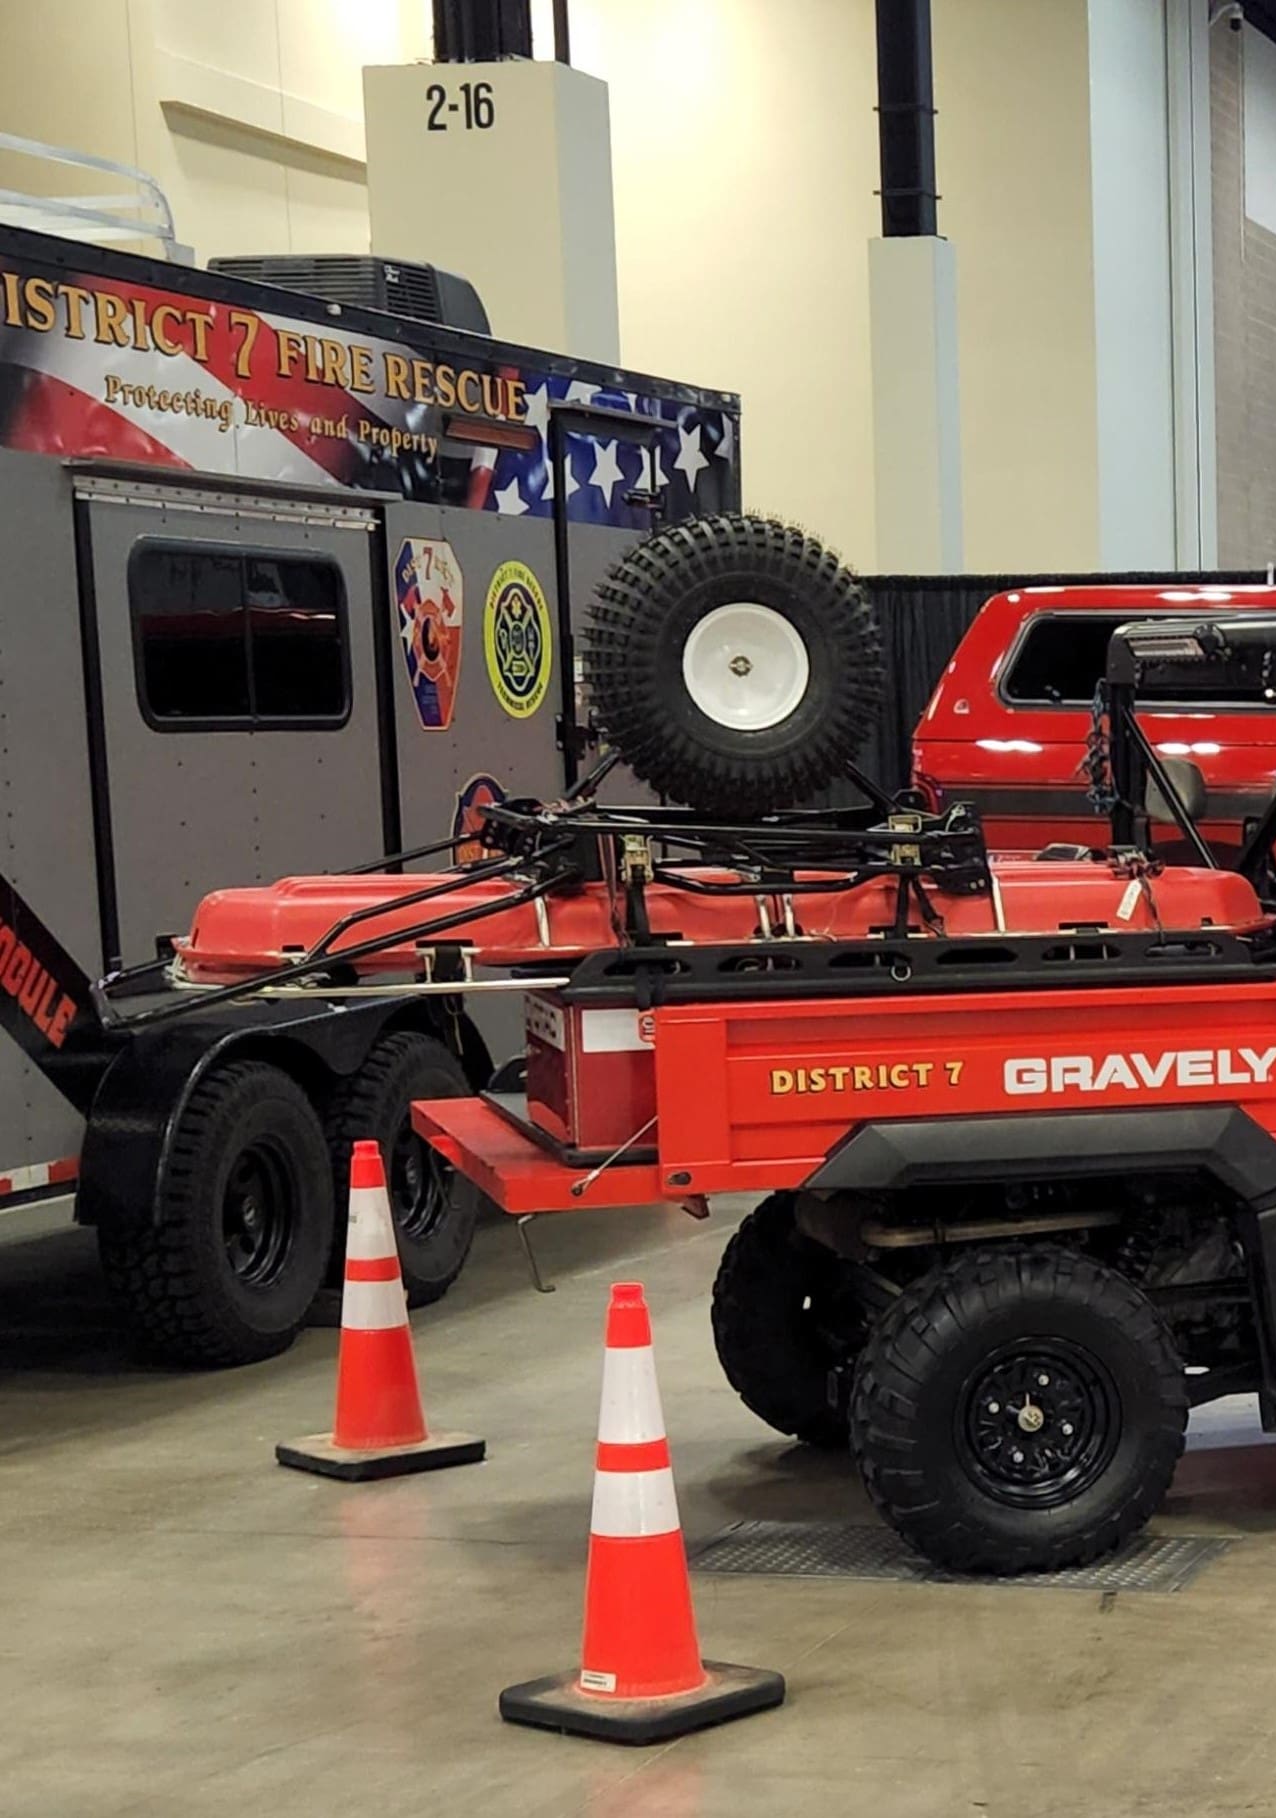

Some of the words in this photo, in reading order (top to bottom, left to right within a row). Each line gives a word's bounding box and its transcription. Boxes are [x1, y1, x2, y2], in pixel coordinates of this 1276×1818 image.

[426, 82, 494, 131] 2-16
[1, 272, 214, 362] ISTRICT
[228, 310, 261, 378] 7
[275, 329, 376, 395] FIRE
[383, 352, 528, 422] RESCUE
[104, 374, 233, 432] Protecting
[244, 403, 299, 430] Lives
[310, 413, 348, 440] and
[359, 419, 439, 463] Property
[423, 546, 434, 580] 7
[770, 1062, 933, 1095] DISTRICT
[943, 1061, 964, 1086] 7
